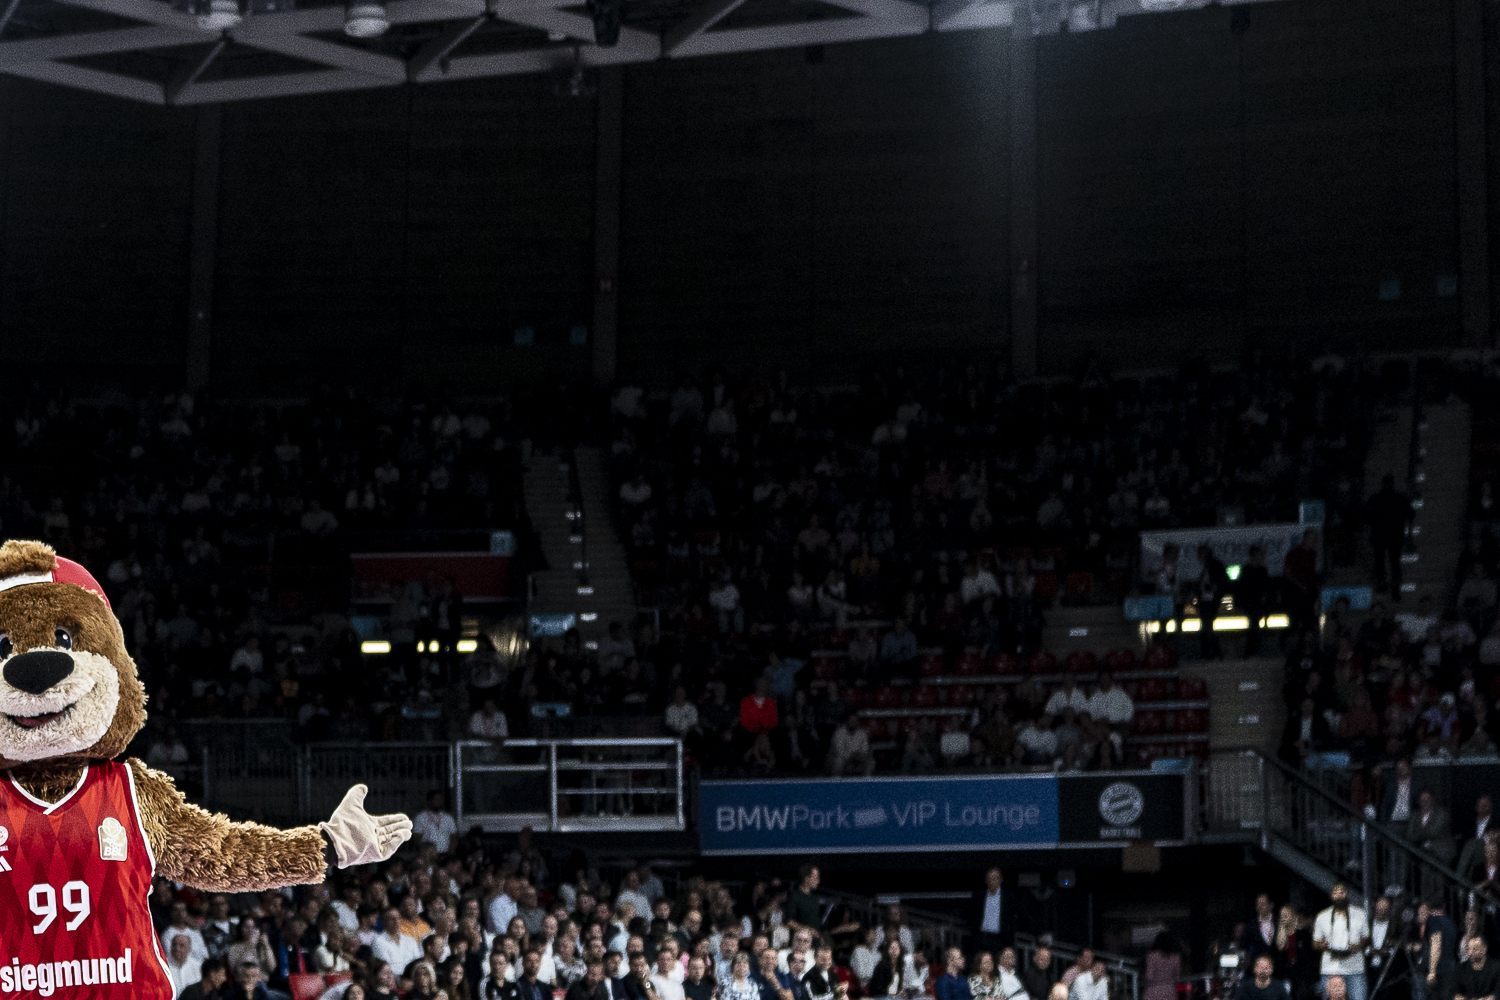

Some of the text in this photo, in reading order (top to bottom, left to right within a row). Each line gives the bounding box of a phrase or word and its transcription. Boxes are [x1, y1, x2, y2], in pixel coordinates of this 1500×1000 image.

[716, 801, 1040, 832] BMWPark VIP Lounge
[27, 879, 91, 935] 99
[0, 948, 133, 997] siegmund
